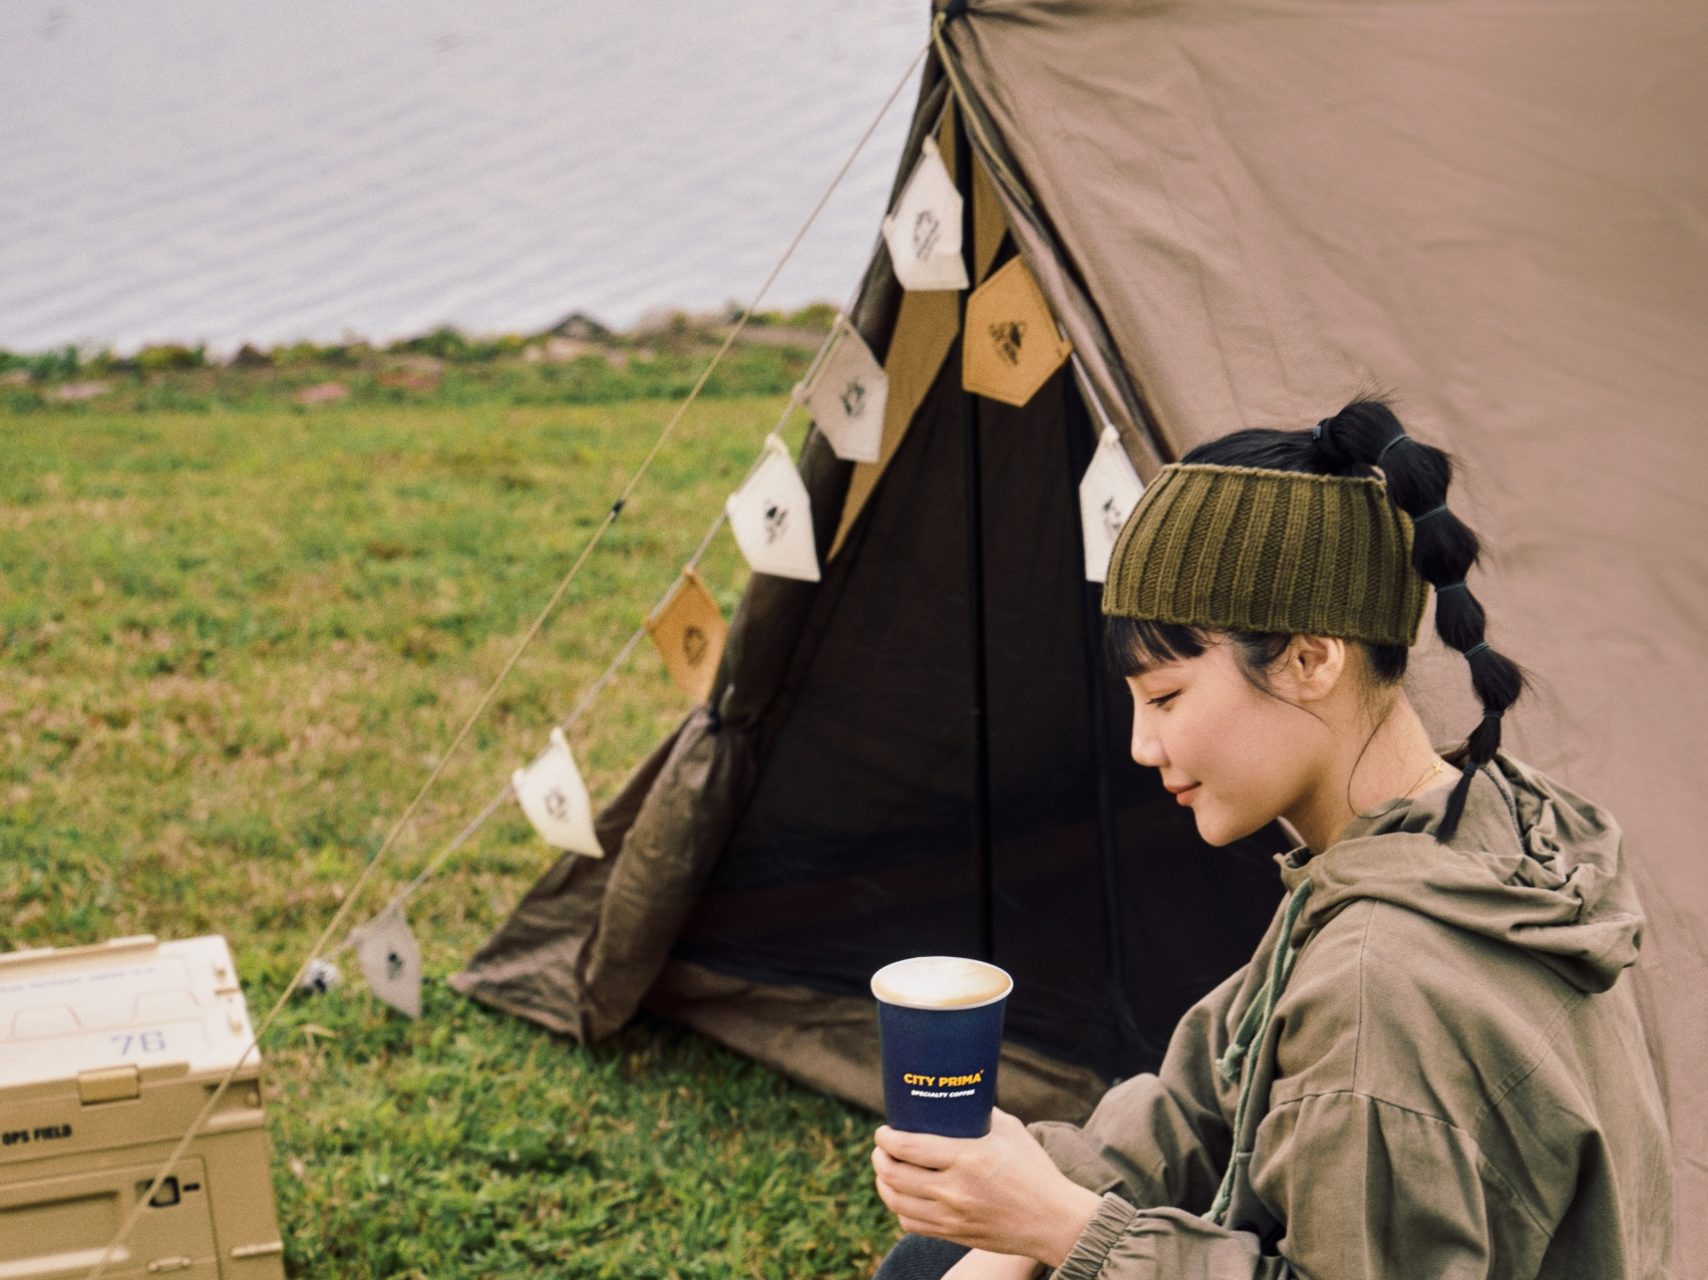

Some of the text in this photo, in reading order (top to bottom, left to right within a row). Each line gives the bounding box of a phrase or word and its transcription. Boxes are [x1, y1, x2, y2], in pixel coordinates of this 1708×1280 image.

[903, 1072, 982, 1087] CITY PRIMA
[910, 1088, 976, 1099] SPECIALTY COFFEE
[33, 1123, 72, 1142] FIELD
